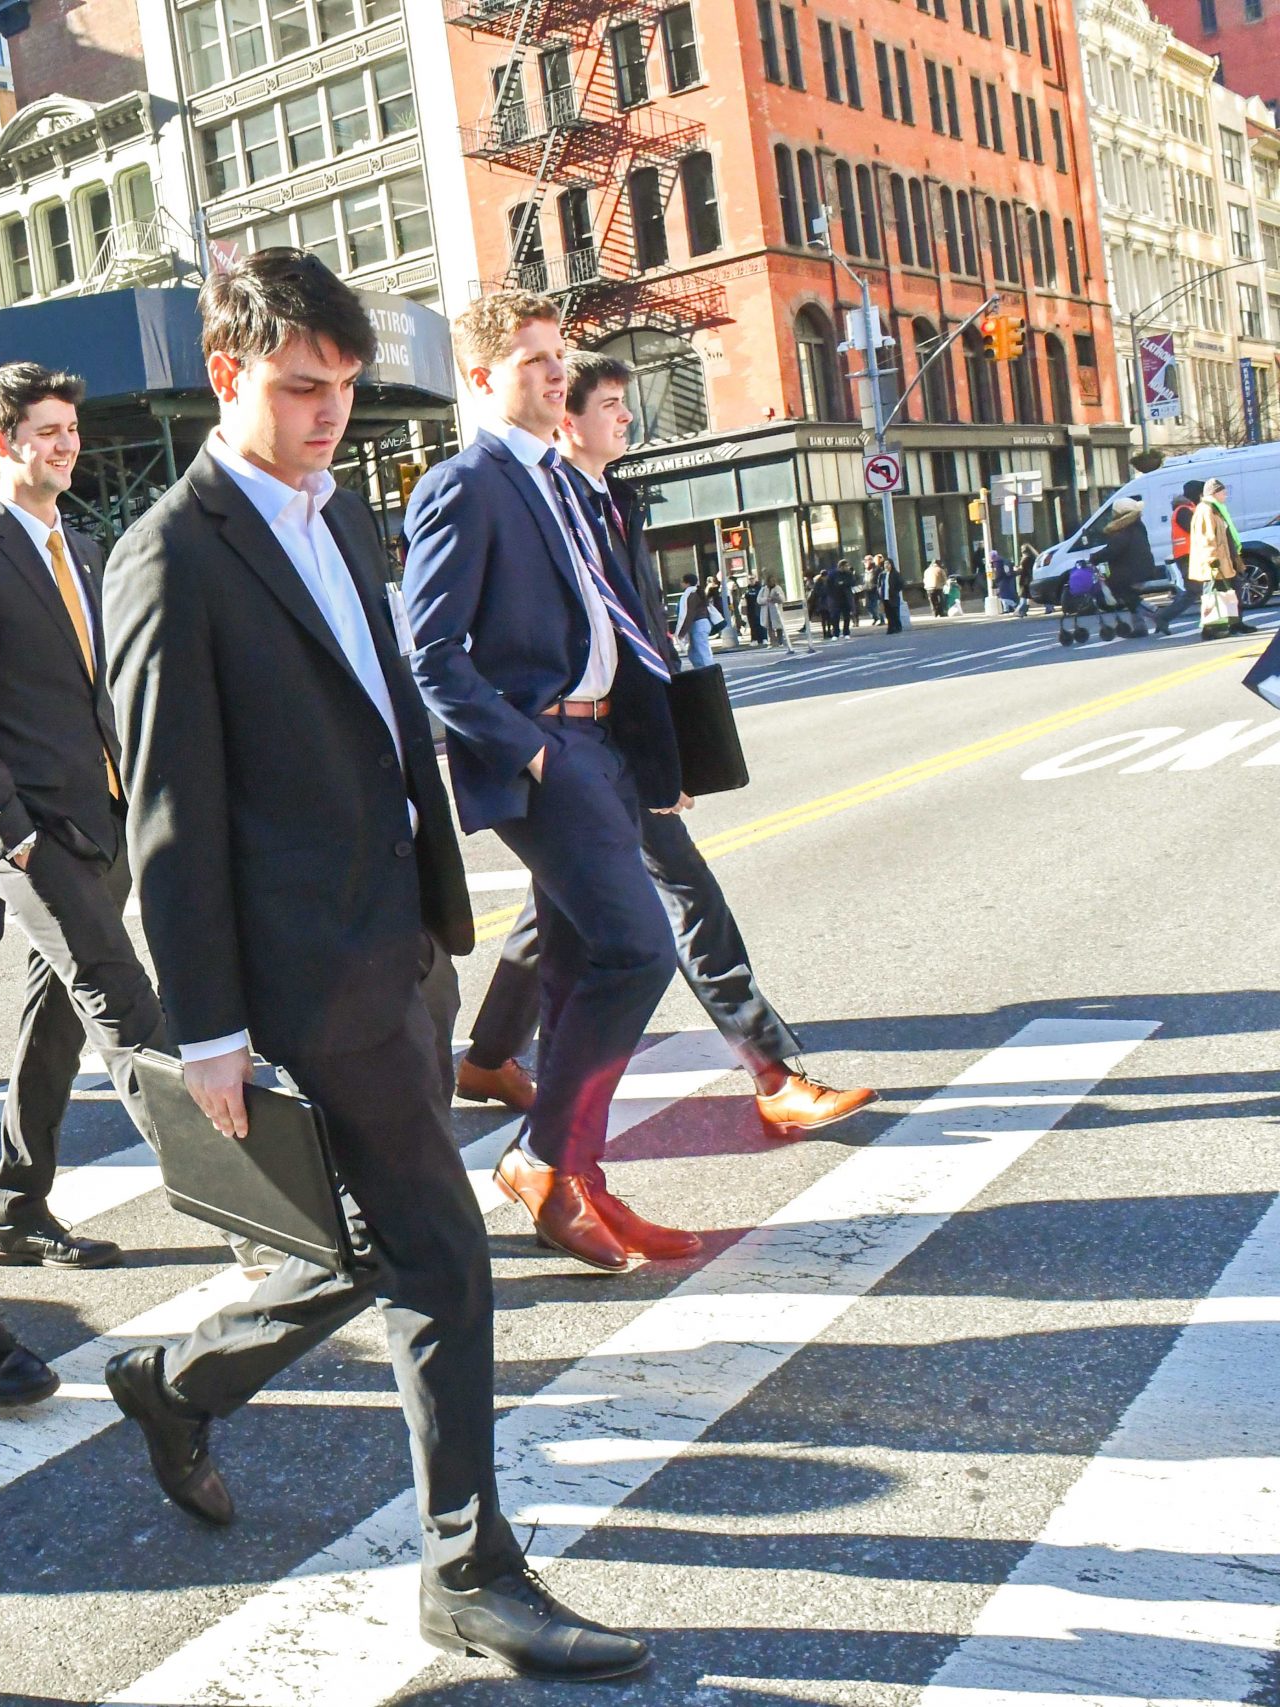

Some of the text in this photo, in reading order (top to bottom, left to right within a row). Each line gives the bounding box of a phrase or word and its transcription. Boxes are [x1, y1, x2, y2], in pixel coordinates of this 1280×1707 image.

[370, 308, 416, 337] ATIRON
[375, 341, 409, 366] DING
[636, 462, 656, 475] OF
[656, 451, 713, 472] AMERICA
[1020, 717, 1280, 780] ON
